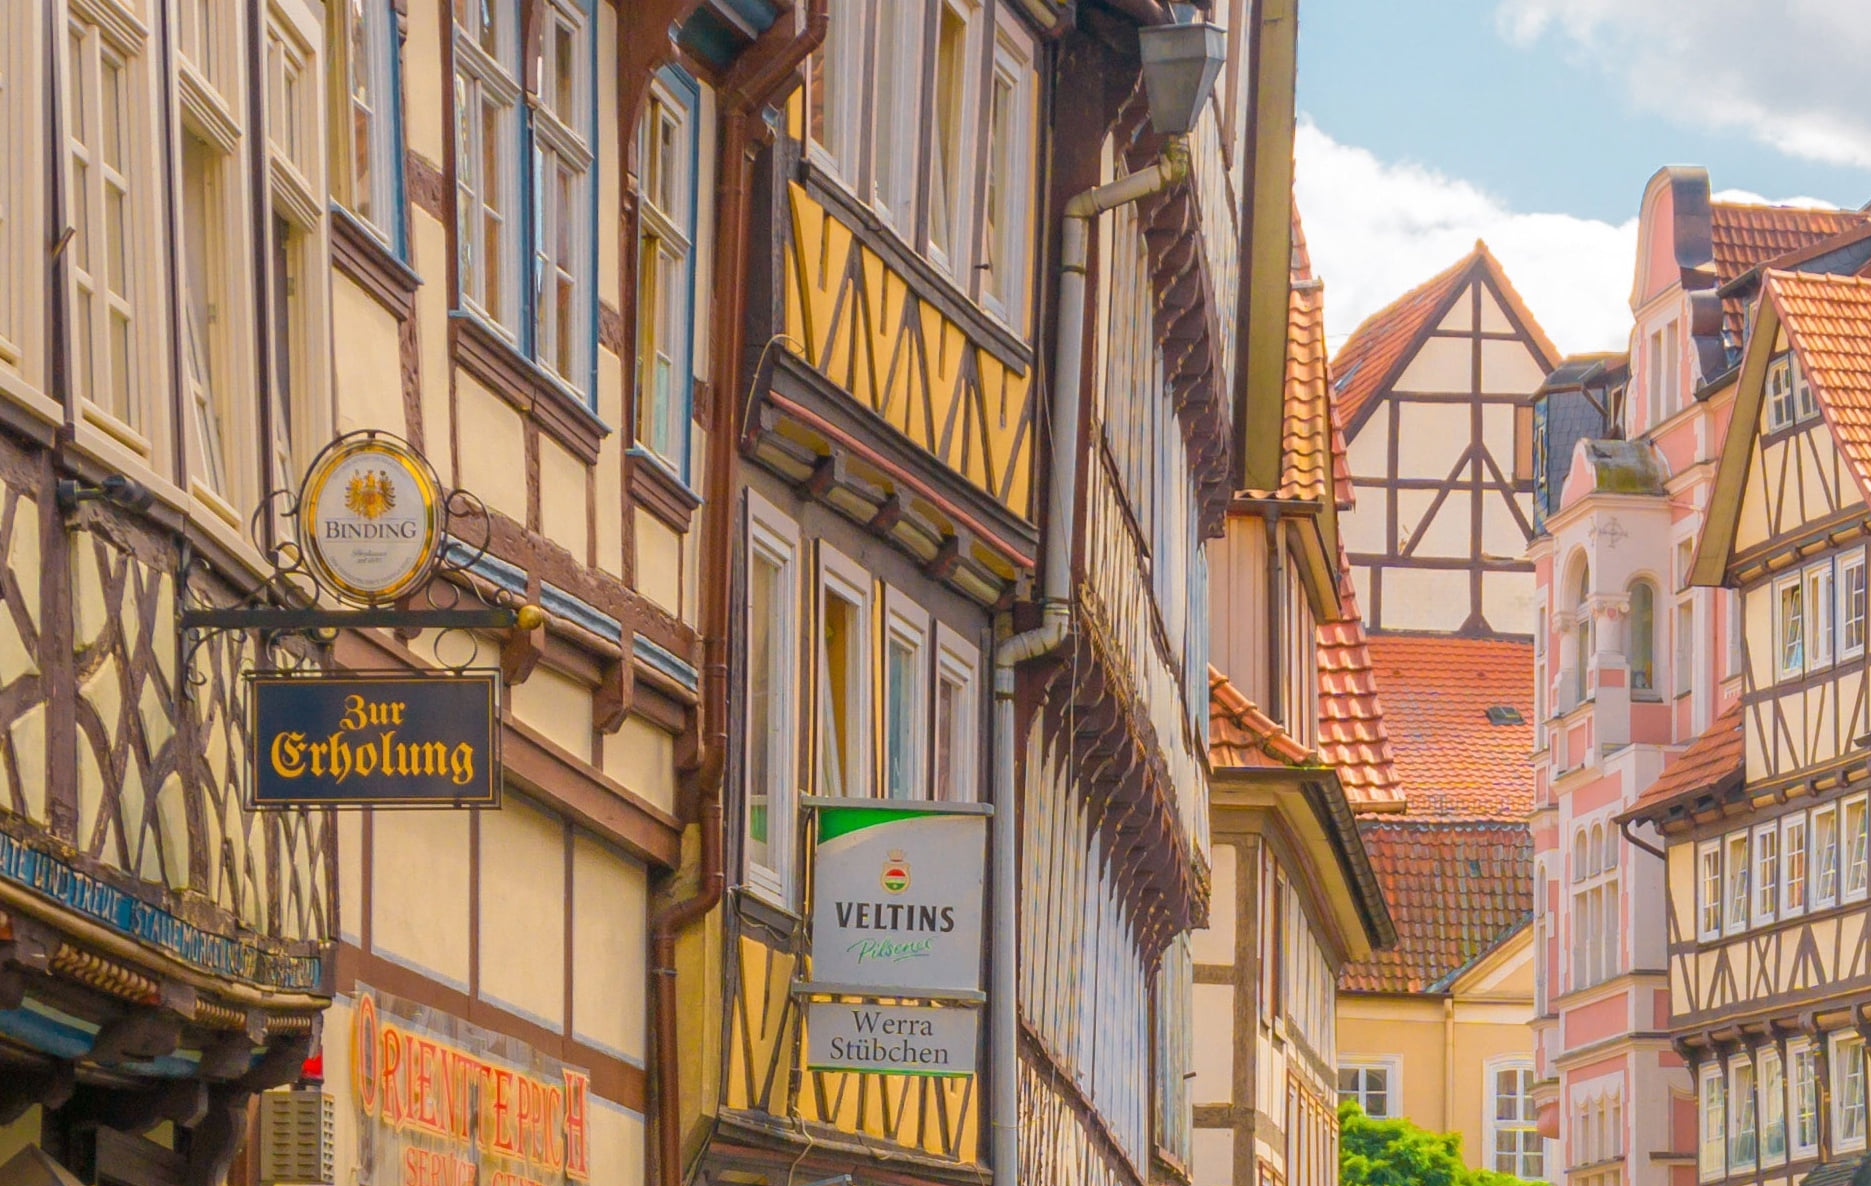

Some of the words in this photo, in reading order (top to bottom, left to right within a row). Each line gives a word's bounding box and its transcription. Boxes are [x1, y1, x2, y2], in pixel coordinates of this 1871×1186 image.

[325, 521, 417, 539] BINDING
[339, 694, 406, 730] Zur
[271, 730, 475, 785] Erholung
[835, 901, 955, 933] VELTINS
[851, 1010, 933, 1036] Werra
[830, 1036, 949, 1064] Stübchen
